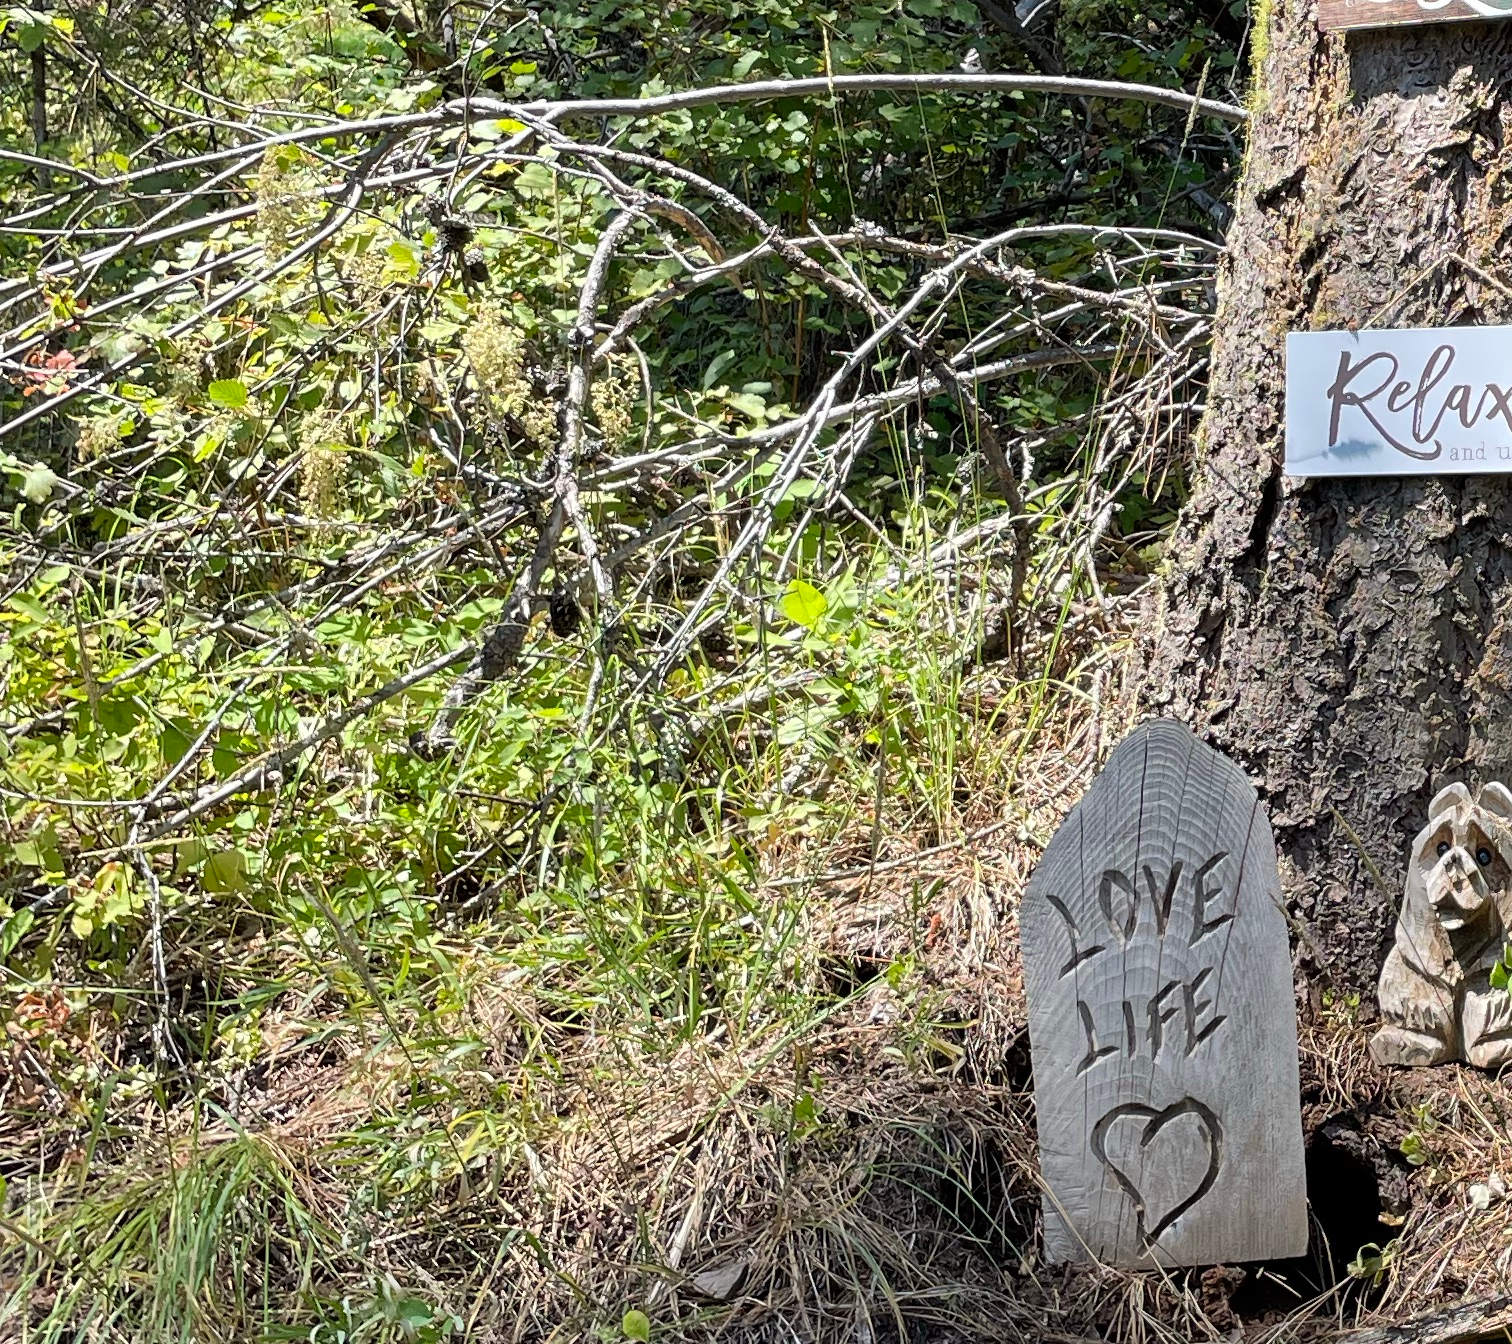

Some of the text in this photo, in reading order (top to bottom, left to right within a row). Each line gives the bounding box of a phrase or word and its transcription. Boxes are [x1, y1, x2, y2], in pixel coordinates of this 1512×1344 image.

[1449, 441, 1486, 461] and
[1046, 851, 1236, 981] LOVE
[1076, 967, 1228, 1077] LIFE
